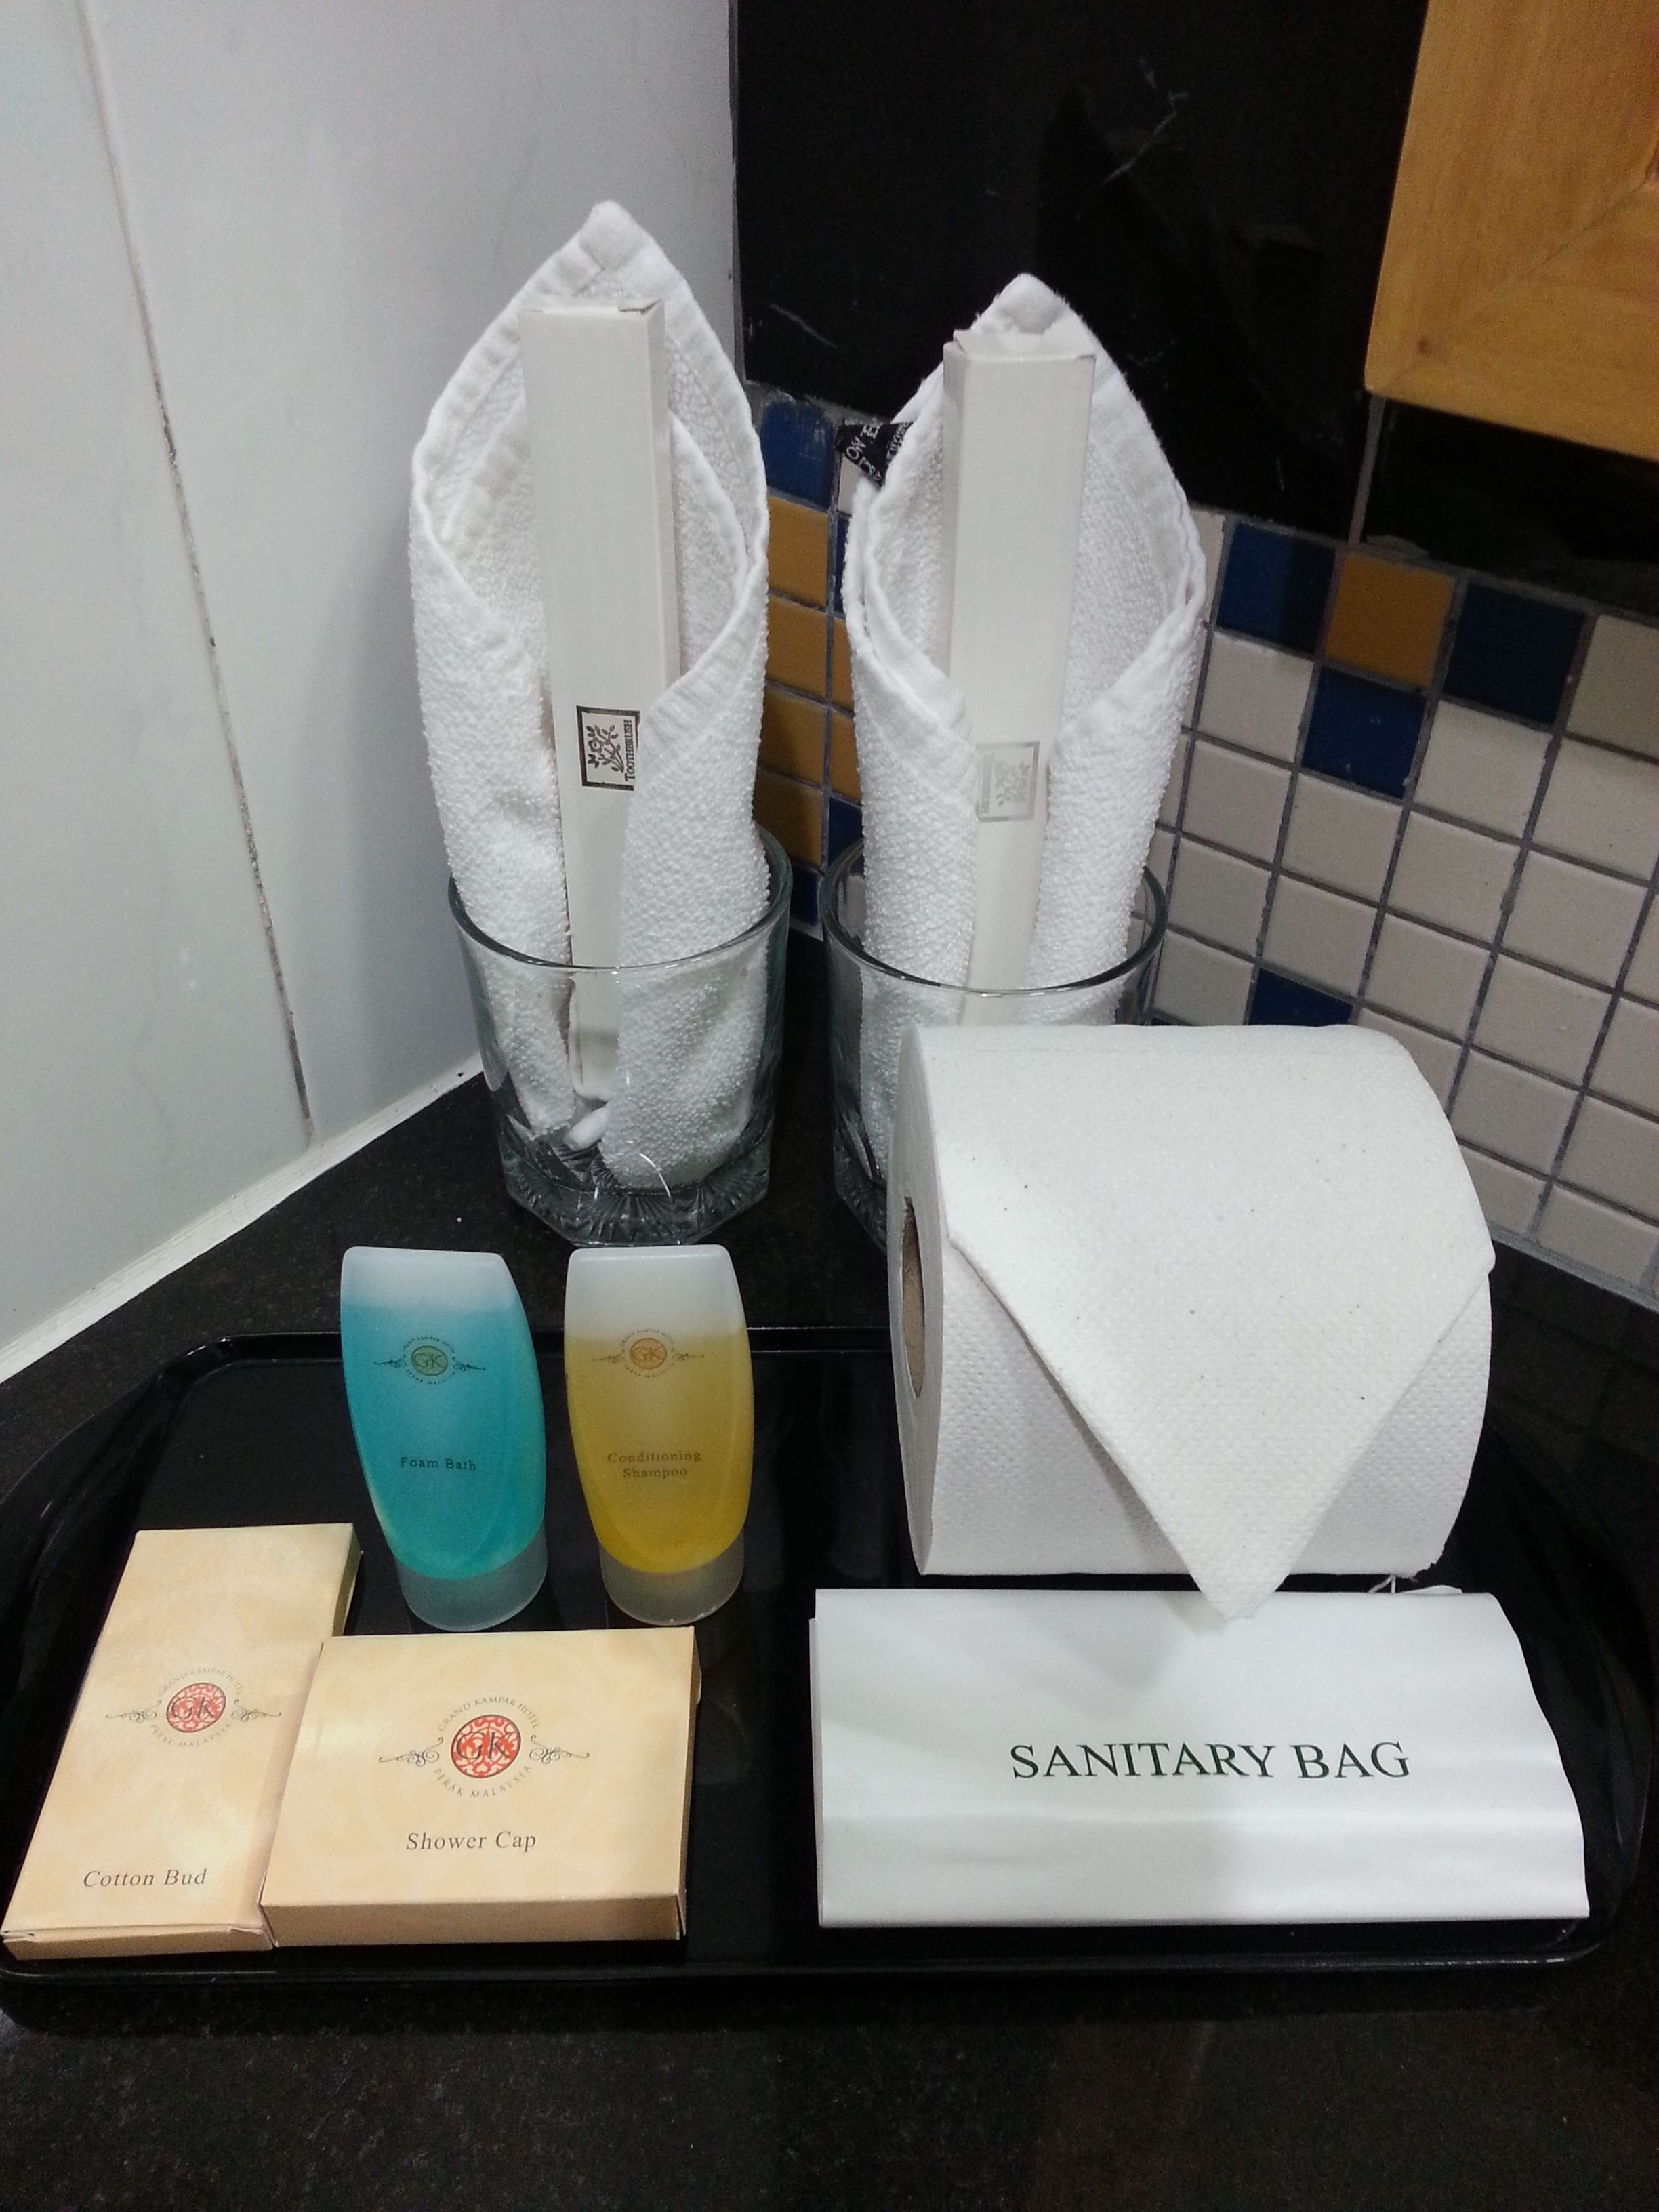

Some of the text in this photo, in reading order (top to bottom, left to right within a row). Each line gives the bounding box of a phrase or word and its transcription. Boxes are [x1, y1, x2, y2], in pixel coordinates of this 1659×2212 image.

[401, 1456, 476, 1471] Foam Bath
[607, 1452, 701, 1464] Conditioning
[623, 1468, 687, 1479] Shampoo
[171, 1696, 217, 1719] GK
[438, 1696, 540, 1732] GRAND KAMPAR HOTEL
[456, 1731, 512, 1761] GK
[1010, 1741, 1410, 1778] SANITARY BAG
[434, 1765, 532, 1798] PERAK MALAYSIA
[407, 1830, 537, 1853] Shower Cap
[83, 1868, 207, 1887] Cotton Bud
